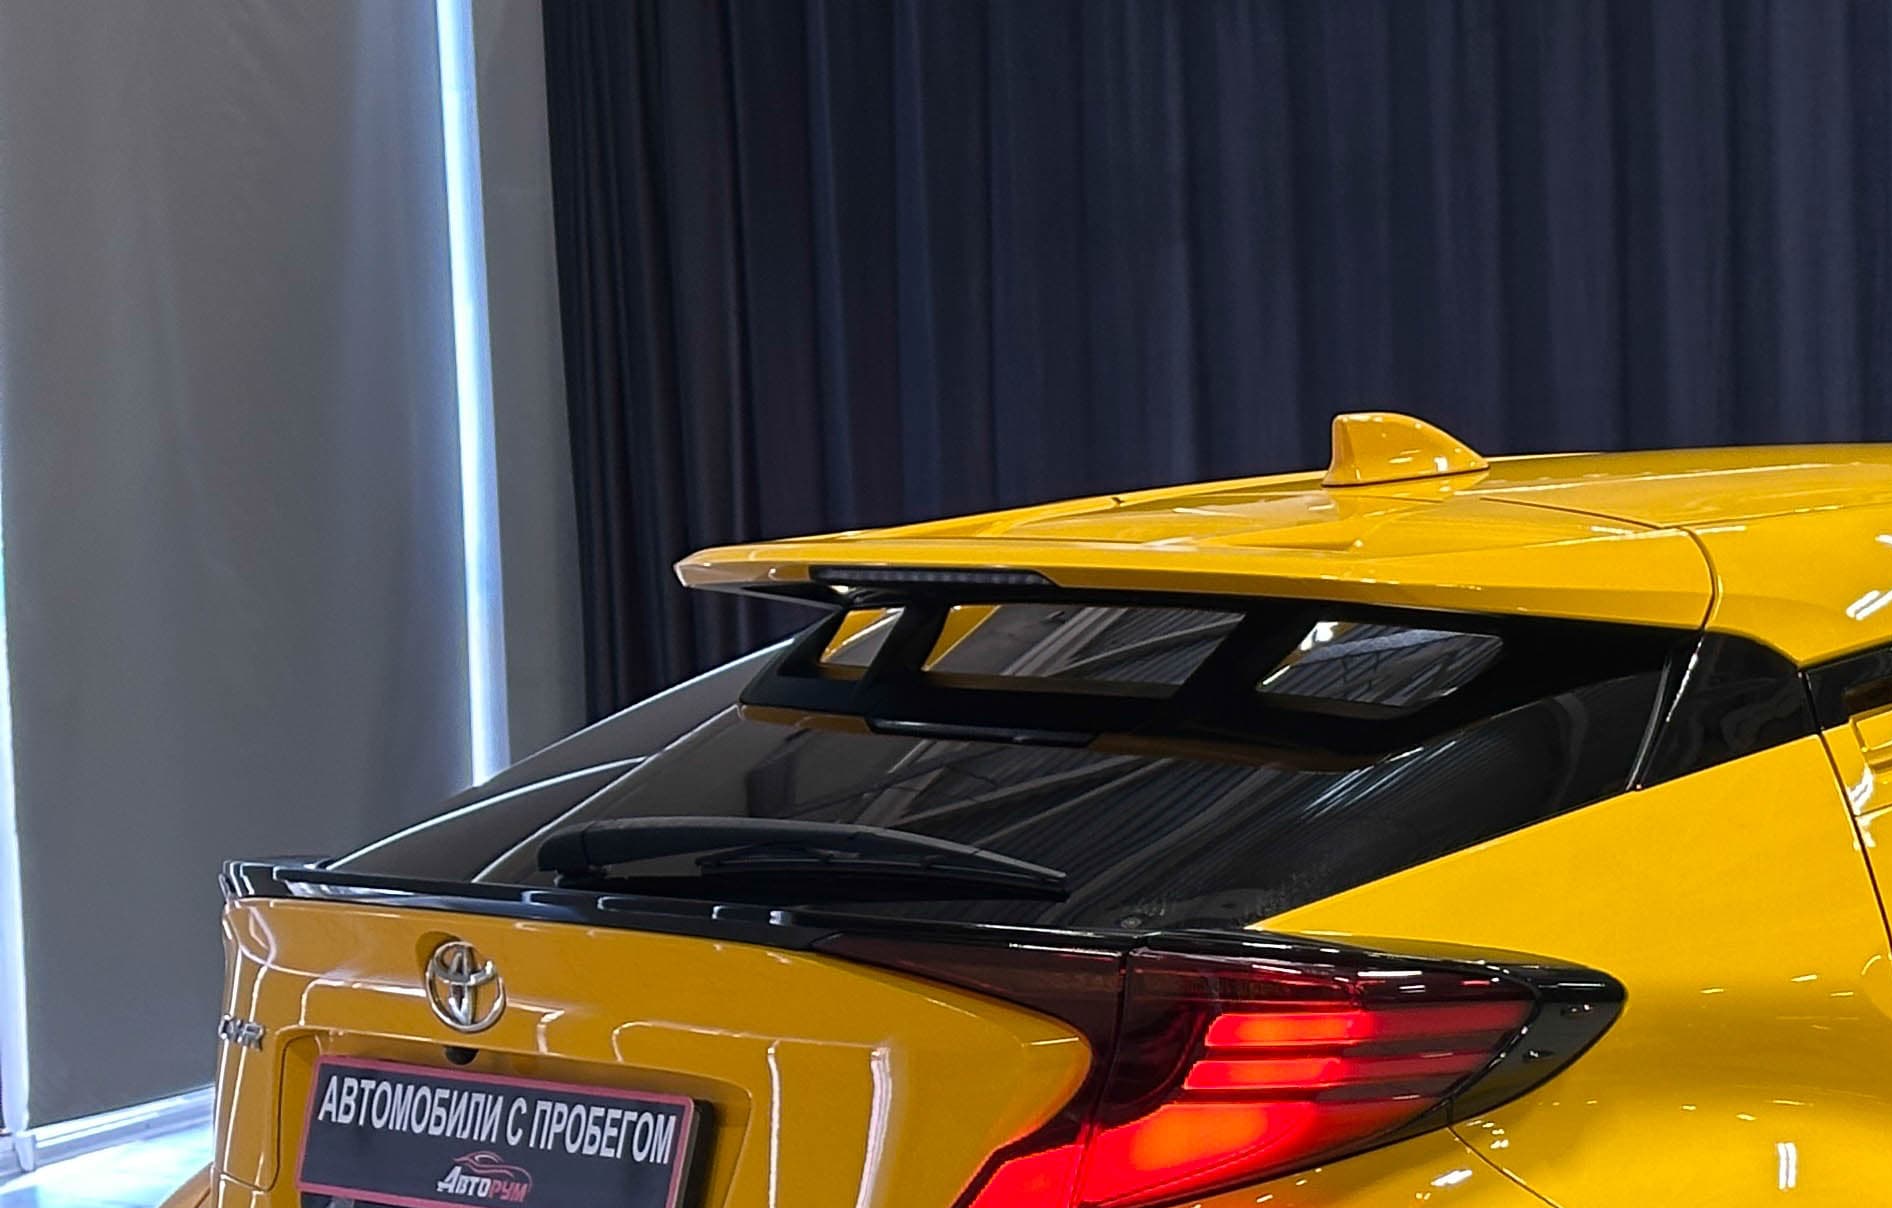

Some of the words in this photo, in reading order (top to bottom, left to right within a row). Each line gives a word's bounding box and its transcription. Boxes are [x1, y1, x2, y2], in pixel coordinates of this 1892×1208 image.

[317, 1075, 504, 1140] АВТОМОБИЛИ
[504, 1096, 524, 1147] С
[528, 1100, 677, 1166] ПРОБЕГОМ
